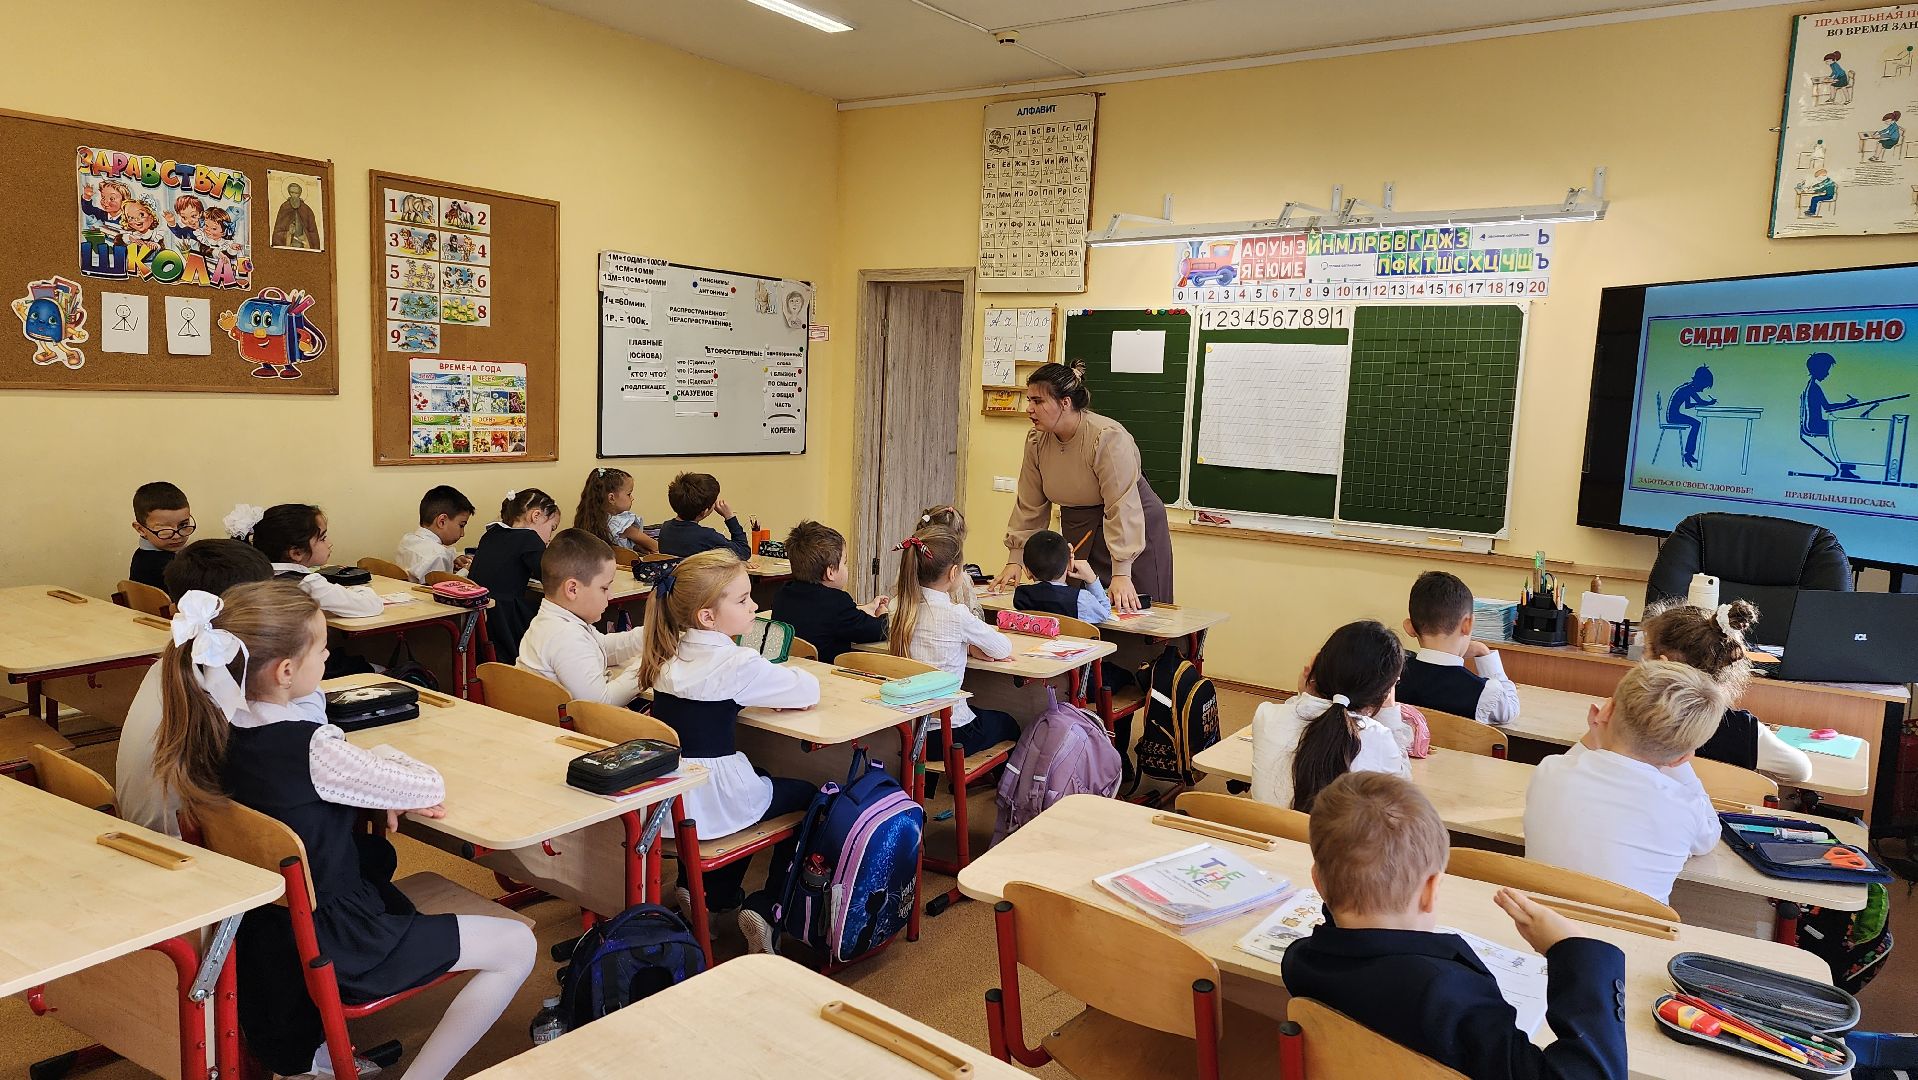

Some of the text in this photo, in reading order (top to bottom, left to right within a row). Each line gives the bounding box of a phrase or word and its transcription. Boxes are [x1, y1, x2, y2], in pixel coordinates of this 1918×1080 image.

[1815, 11, 1903, 27] ПРАВИЛЬНАЯ
[1827, 29, 1842, 37] ВО
[1846, 23, 1888, 35] ВРЕМЯ
[1017, 105, 1057, 117] АЛФАВИТ
[78, 147, 245, 202] ЗДРАВСТВУЙ
[389, 199, 486, 225] 1 2
[1538, 229, 1549, 244] Ь
[390, 233, 487, 258] 3 4
[390, 265, 486, 288] 5 6
[1178, 282, 1546, 300] 0 1 2 3 4 5 6 7 8 9 10 11 12 13 14 15 16 17 18 19 20
[390, 298, 487, 319] 7 8
[391, 330, 400, 343] 9
[1680, 319, 1905, 348] СИДИ ПРАВИЛЬНО
[440, 363, 501, 373] ВРЕМЕНА ГОДА
[1785, 491, 1896, 508] ПРАВИЛЬНАЯ ПОСАДКА
